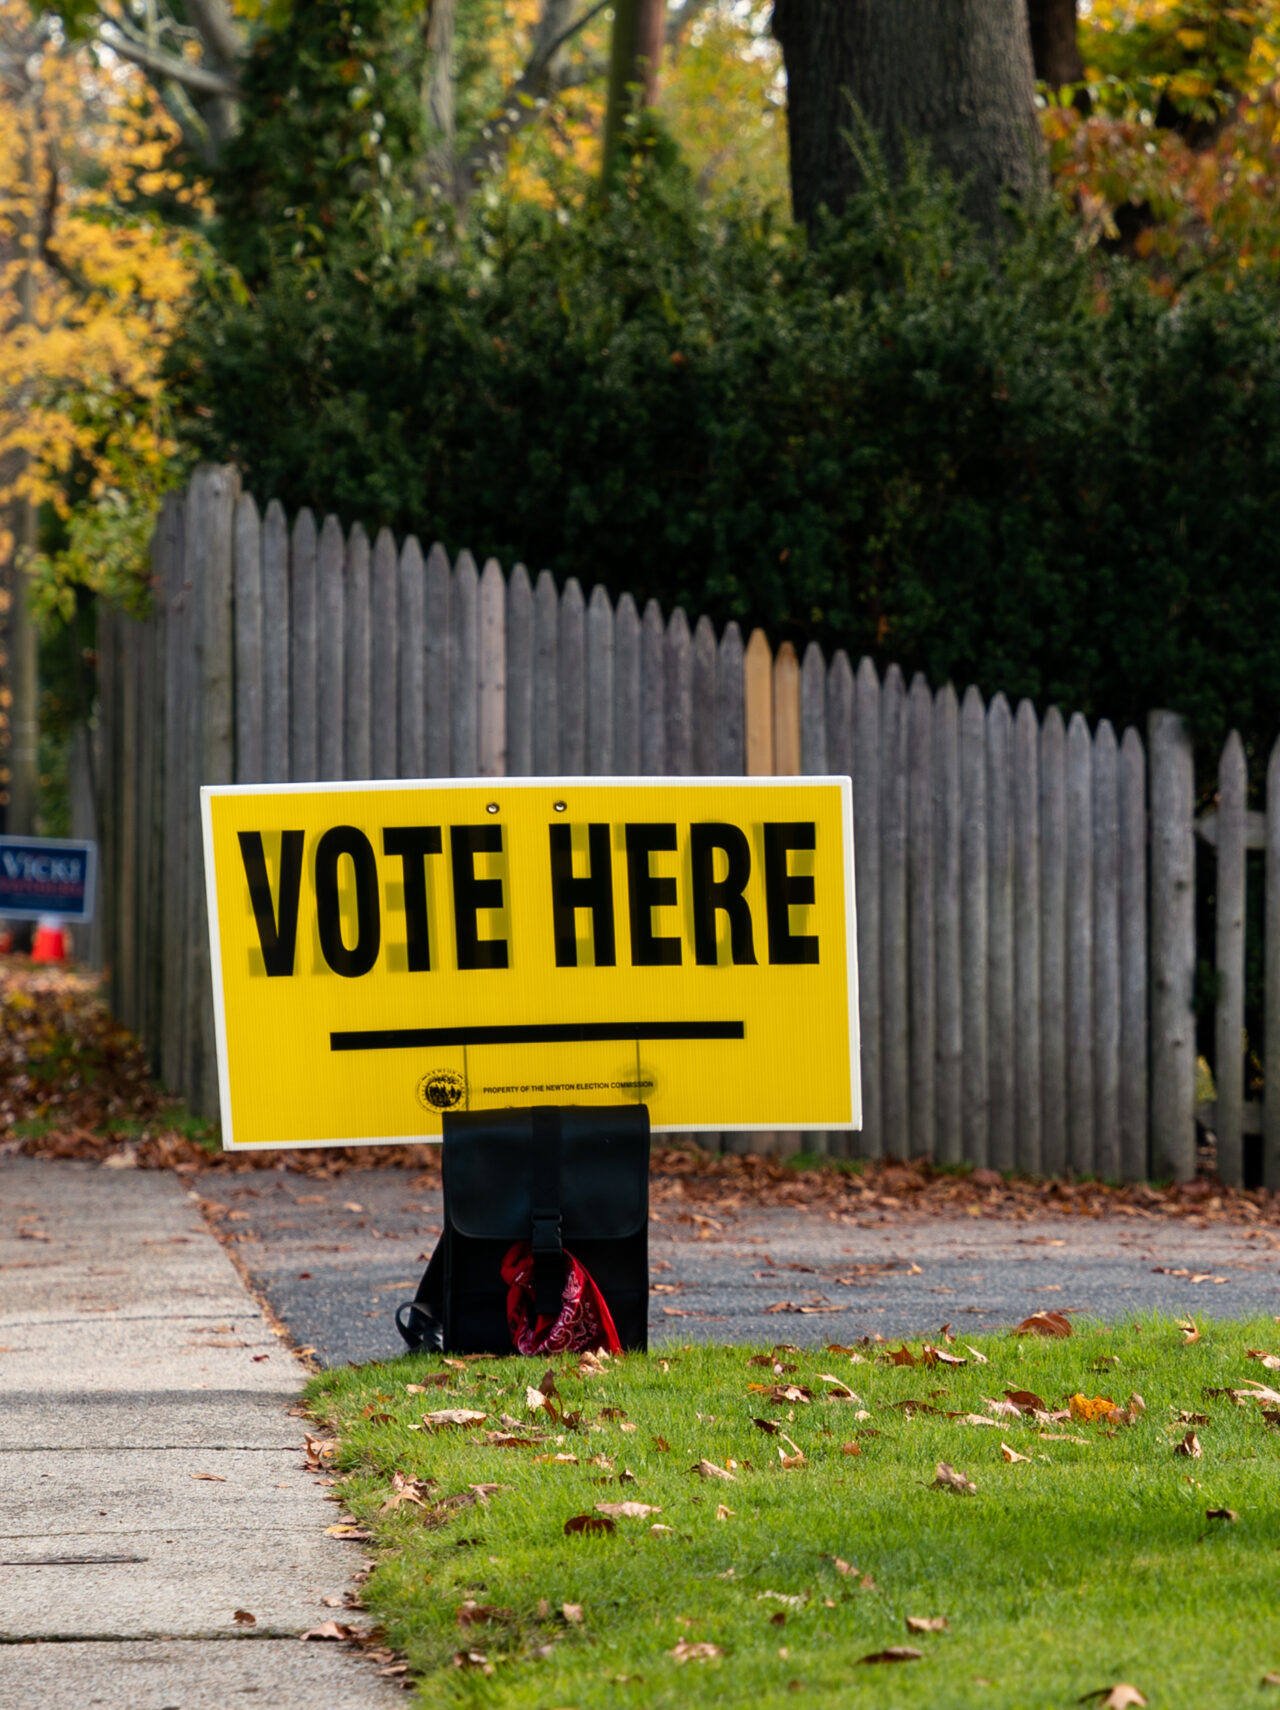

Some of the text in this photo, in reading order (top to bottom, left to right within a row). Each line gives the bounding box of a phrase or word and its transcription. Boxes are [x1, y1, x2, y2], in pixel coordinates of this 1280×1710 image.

[237, 821, 821, 978] VOTE HERE
[483, 1081, 654, 1094] PROPERTY OF THE NEWTON ELECTION COMMISSION
